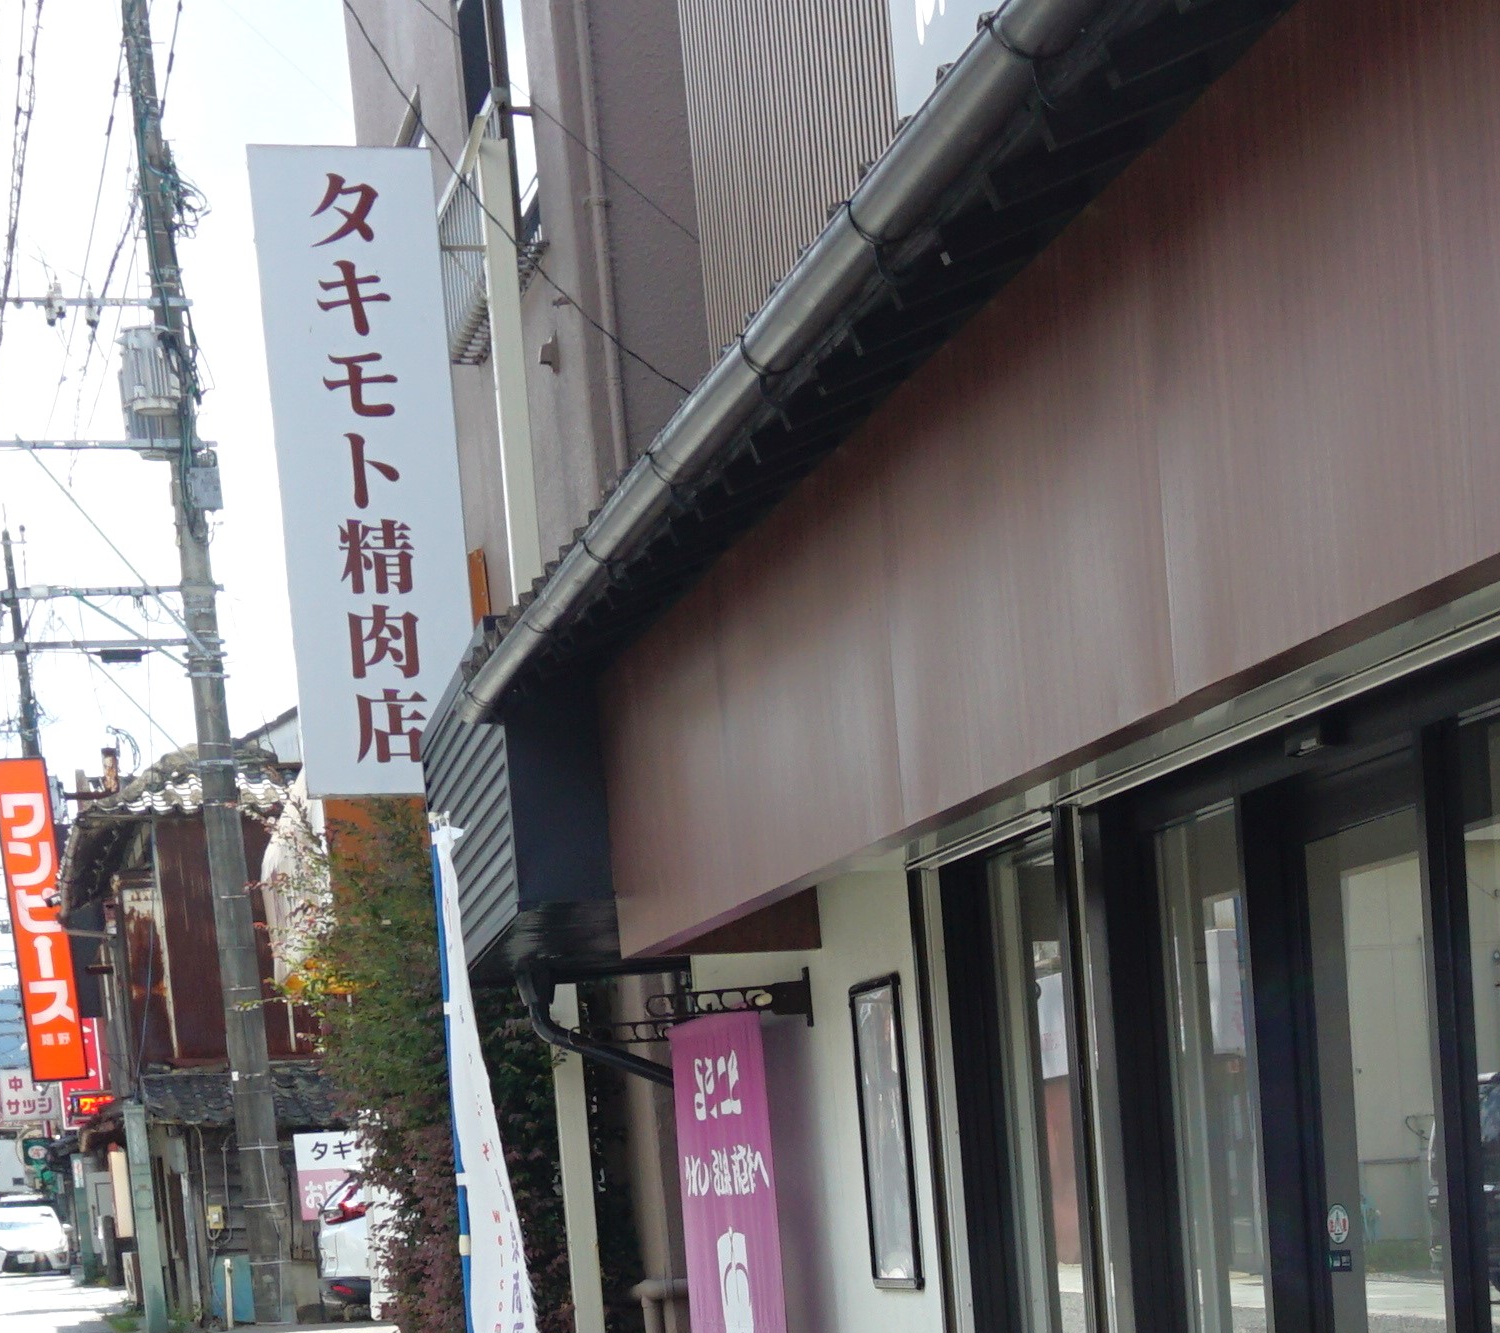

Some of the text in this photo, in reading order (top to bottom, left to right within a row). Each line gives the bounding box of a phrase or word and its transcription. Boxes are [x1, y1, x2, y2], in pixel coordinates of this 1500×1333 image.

[310, 172, 428, 764] タキモト精肉店
[2, 793, 76, 1025] ワンピース
